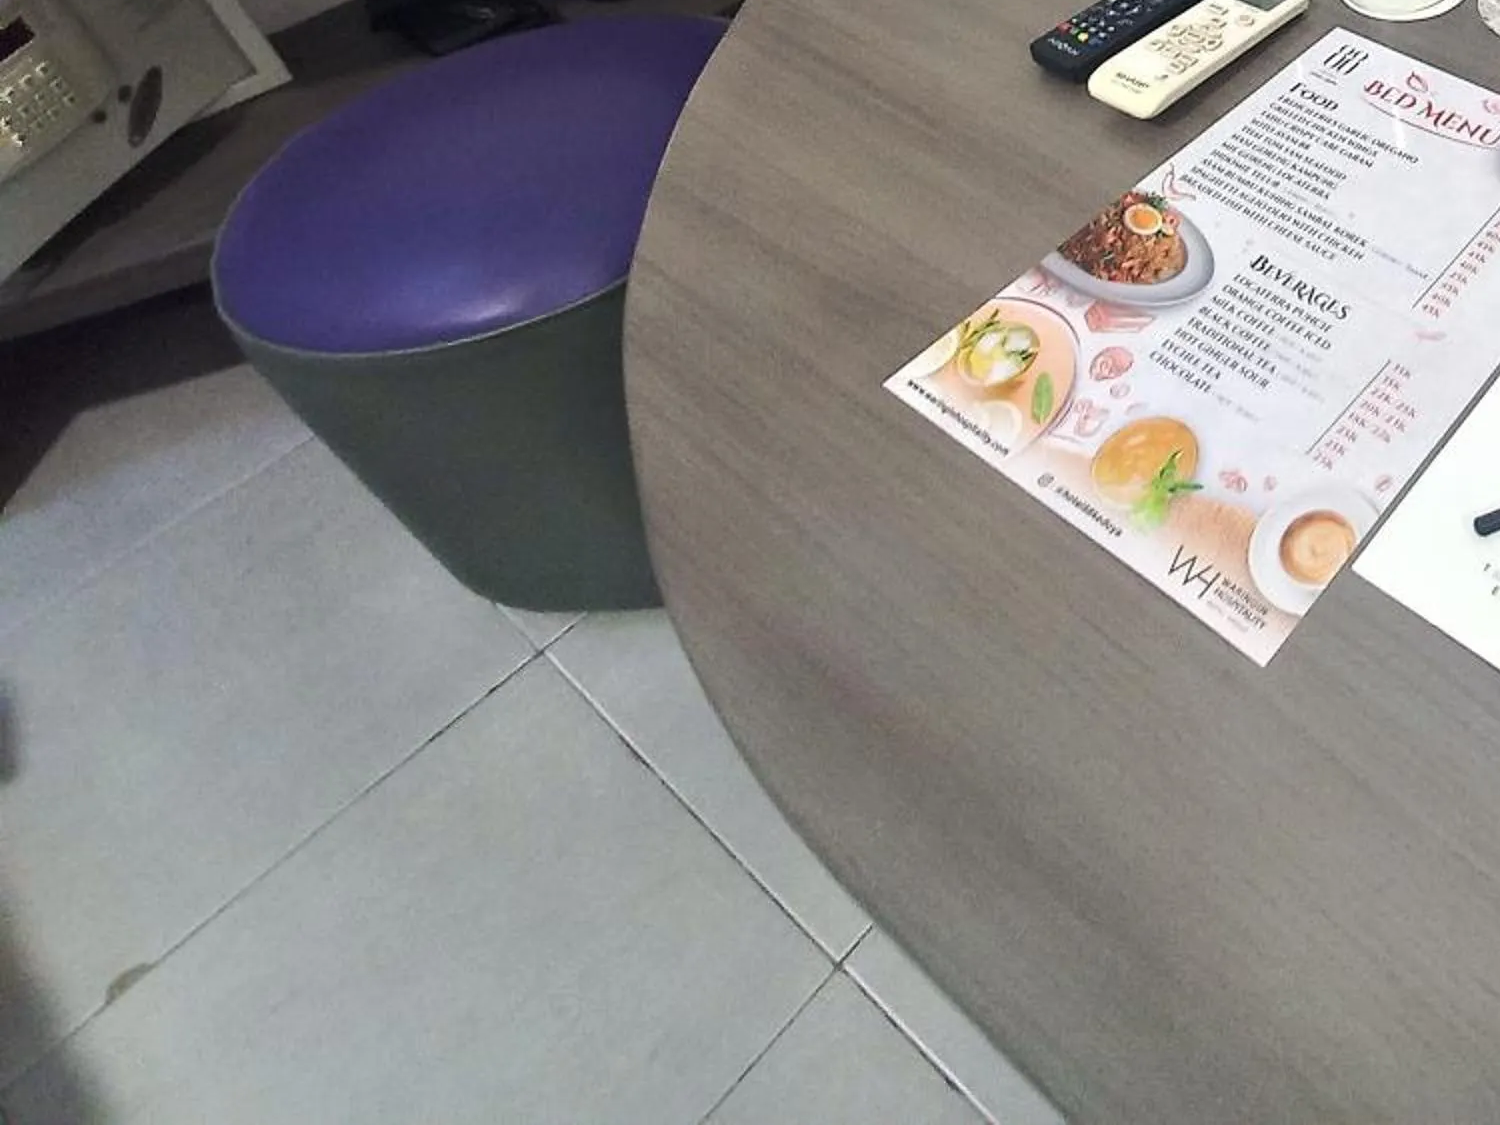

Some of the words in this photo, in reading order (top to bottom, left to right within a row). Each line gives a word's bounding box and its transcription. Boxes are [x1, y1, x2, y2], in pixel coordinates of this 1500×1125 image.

[1360, 79, 1420, 111] BED
[1371, 138, 1419, 164] OREGANO
[1317, 232, 1365, 261] CHICKEN
[1249, 254, 1347, 320] BEVERAGES
[1222, 284, 1265, 312] ORANGE
[1264, 308, 1304, 334] COFFEE
[1236, 309, 1275, 336] COFFEE
[1187, 316, 1255, 361] TRADITIONAL
[1254, 356, 1278, 375] TEA
[1198, 306, 1231, 330] BLACK
[1231, 325, 1271, 352] COFFEE
[1149, 350, 1212, 393] CHOCOLATE
[1200, 361, 1223, 381] TEA
